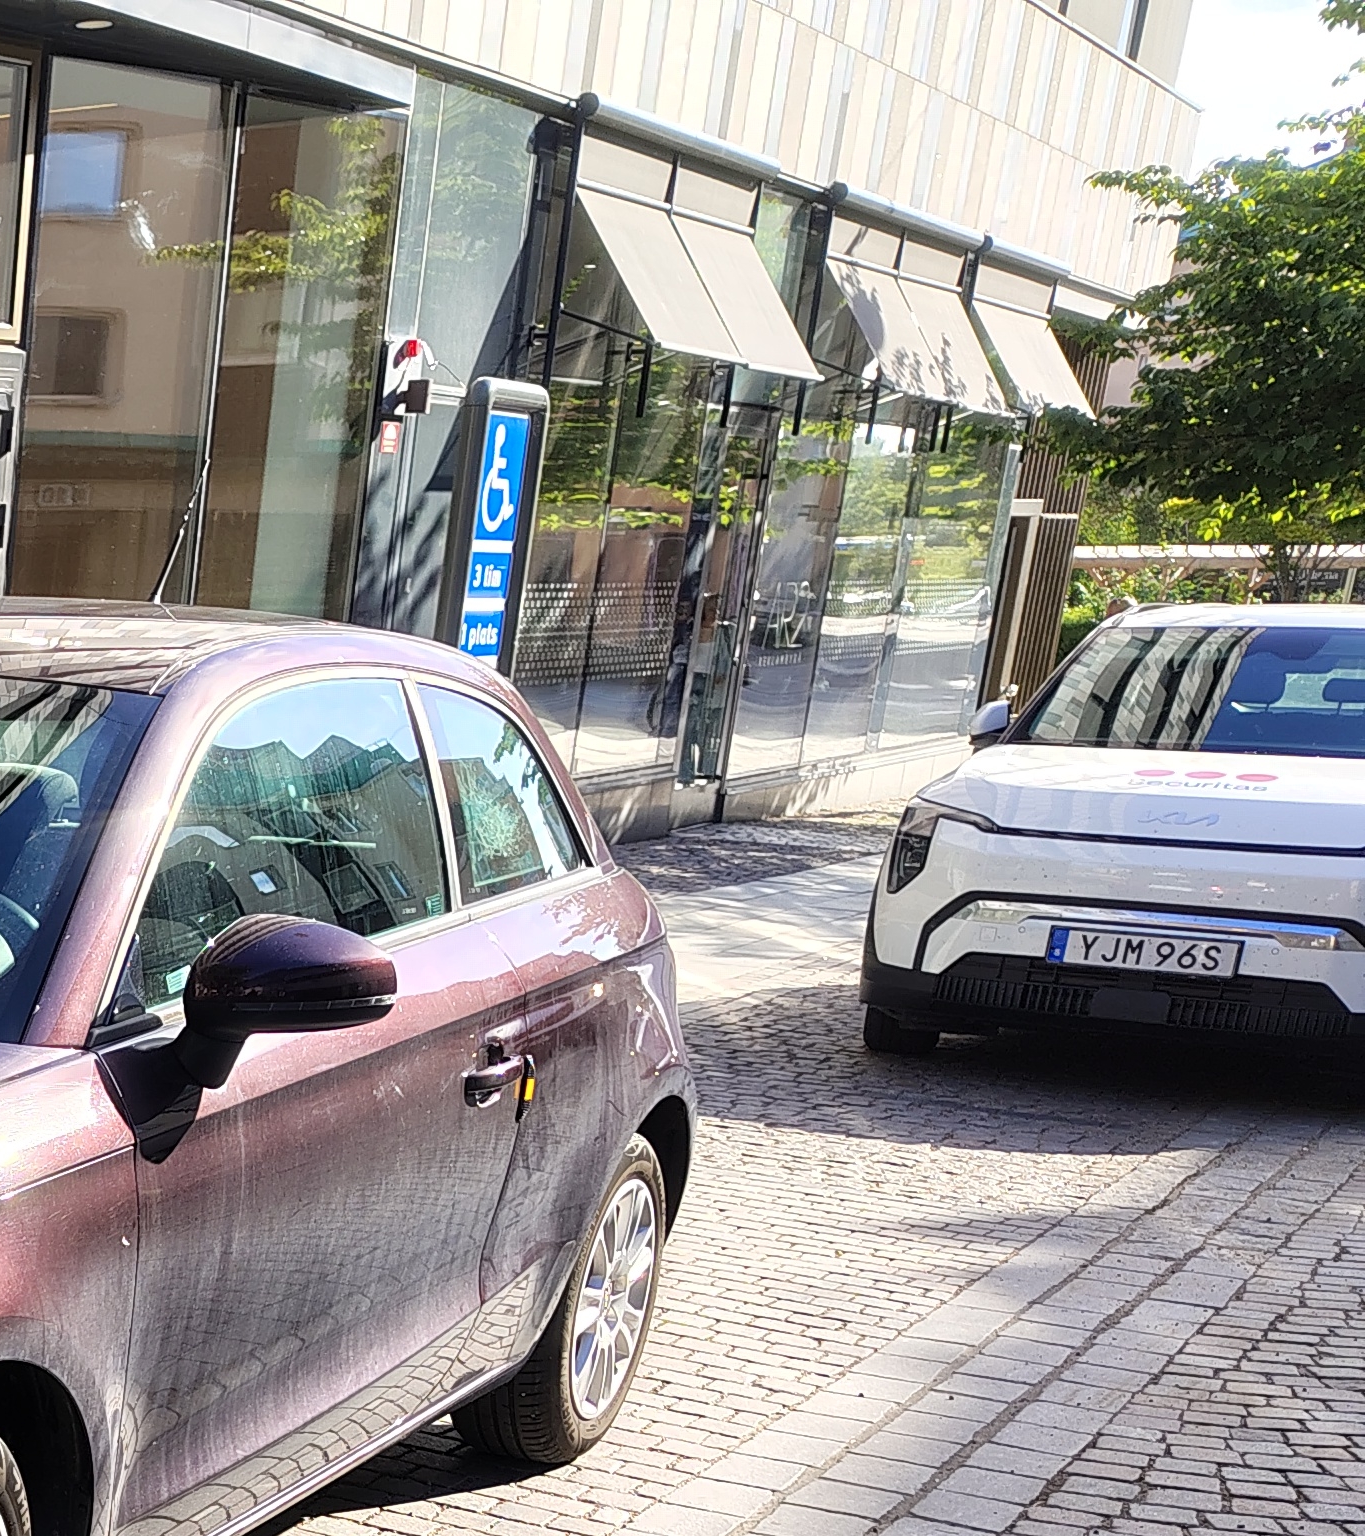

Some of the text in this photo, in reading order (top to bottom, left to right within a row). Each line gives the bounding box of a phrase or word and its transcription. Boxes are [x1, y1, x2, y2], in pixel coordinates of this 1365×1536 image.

[472, 563, 502, 588] 3 tim
[461, 622, 499, 651] 1 plats
[1081, 934, 1222, 971] YJM 96S
